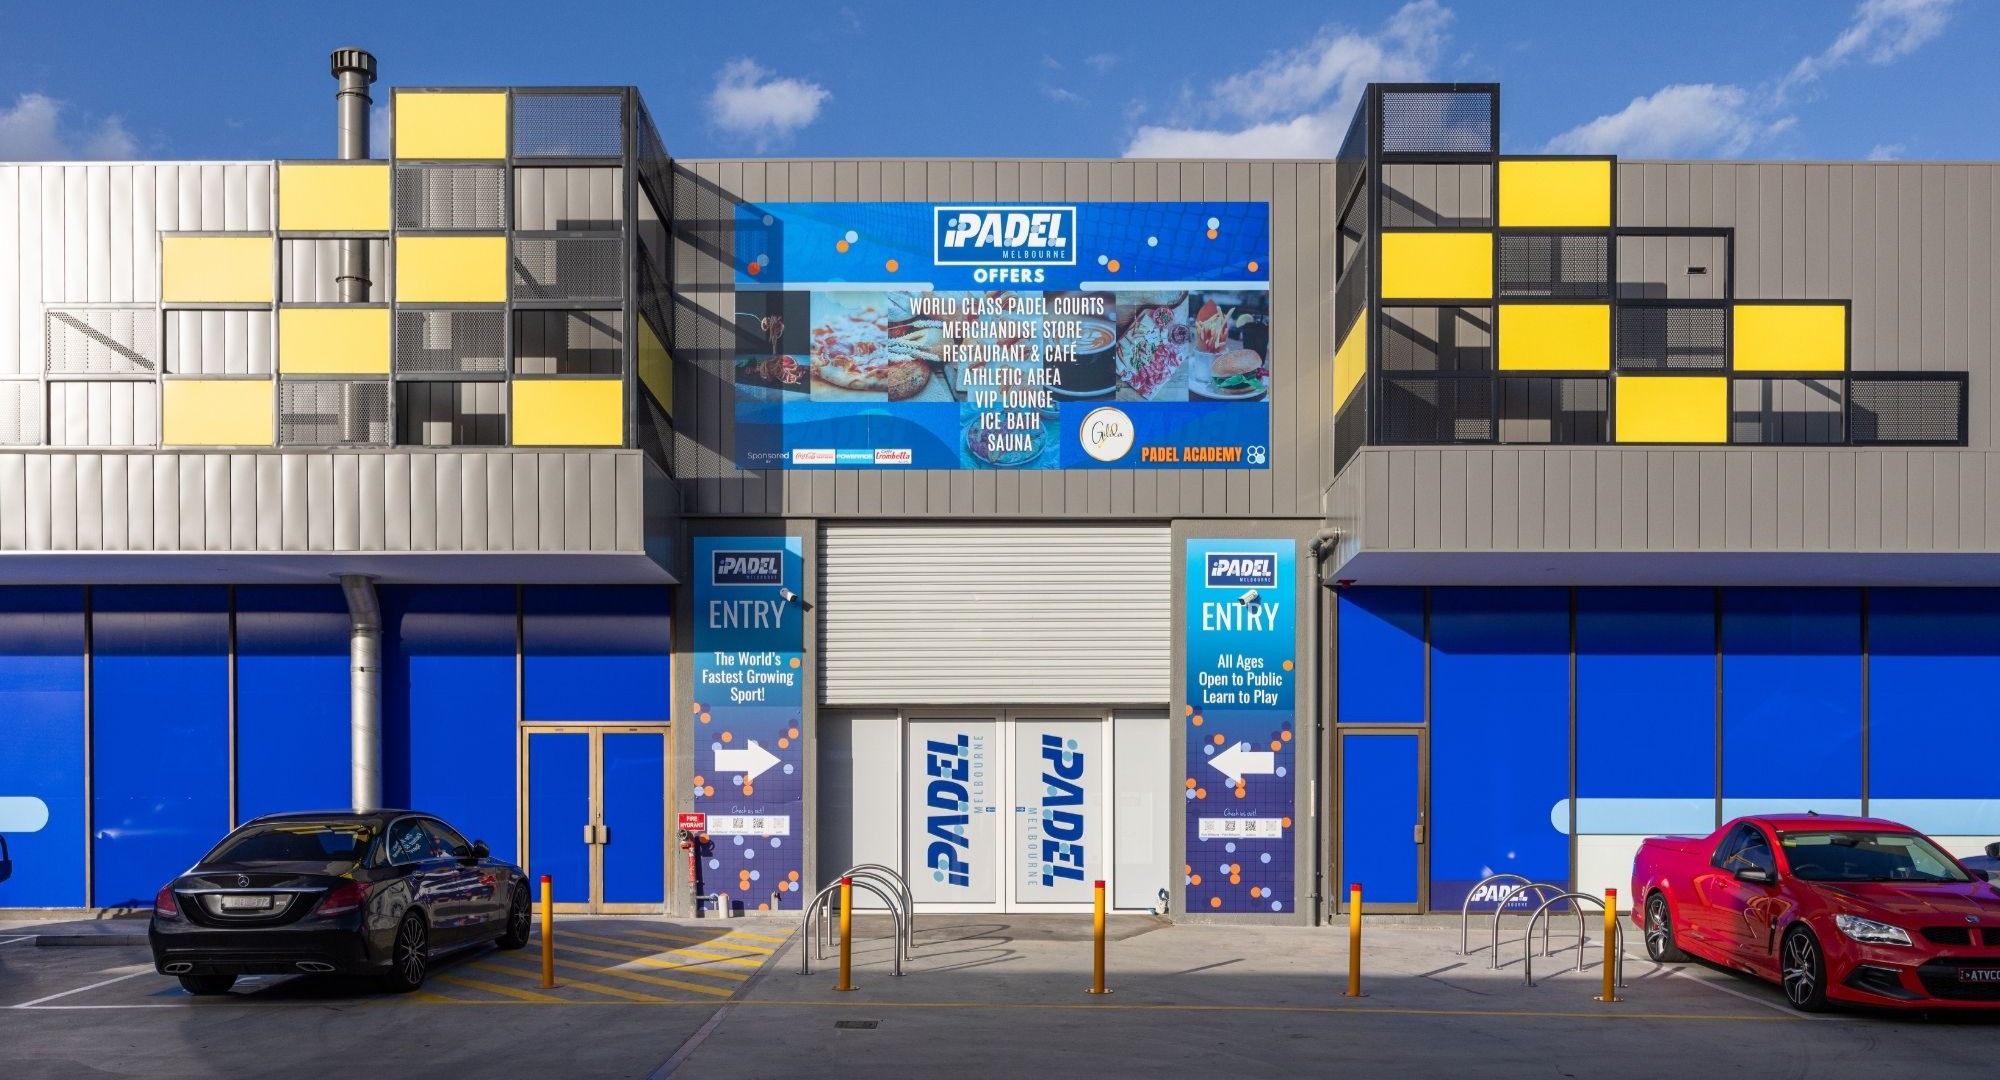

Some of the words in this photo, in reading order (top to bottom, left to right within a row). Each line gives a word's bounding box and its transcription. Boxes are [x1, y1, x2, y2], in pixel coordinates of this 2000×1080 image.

[944, 213, 1066, 248] iPADEL
[1002, 250, 1066, 259] MELBOURNE
[973, 268, 1045, 283] OFFERS
[910, 297, 956, 316] WORLD
[962, 297, 1003, 316] CLASS
[1008, 297, 1048, 316] PADEL
[1054, 297, 1104, 316] COURTS
[942, 320, 1037, 339] MERCHANDISE
[1043, 320, 1082, 339] STORE
[943, 344, 1027, 362] RESTAURANT
[1031, 344, 1040, 362] &
[1045, 341, 1077, 362] CAFÉ
[963, 368, 1022, 386] ATHLETIC
[1027, 368, 1062, 386] AREA
[975, 390, 999, 409] VIP
[1003, 390, 1054, 409] LOUNGE
[980, 412, 1001, 430] ICE
[1007, 412, 1040, 430] BATH
[988, 434, 1033, 452] SAUNA
[747, 451, 790, 460] Sponsored
[1141, 446, 1179, 462] PADEL
[1183, 446, 1242, 462] ACADEMY
[709, 600, 786, 629] ENTRY
[1202, 602, 1280, 632] ENTRY
[714, 652, 735, 666] The
[1217, 654, 1233, 668] All
[1236, 654, 1264, 671] Ages
[702, 669, 743, 684] Fastest
[746, 669, 794, 686] Growing
[1199, 671, 1228, 688] Open
[1231, 673, 1244, 686] to
[1247, 671, 1283, 686] Public
[730, 687, 765, 704] Sport!
[1203, 689, 1235, 704] Learn
[1238, 691, 1250, 704] to
[1254, 689, 1278, 706] Play
[974, 735, 983, 814] MELBOURNE
[1028, 807, 1038, 886] MELBOURNE
